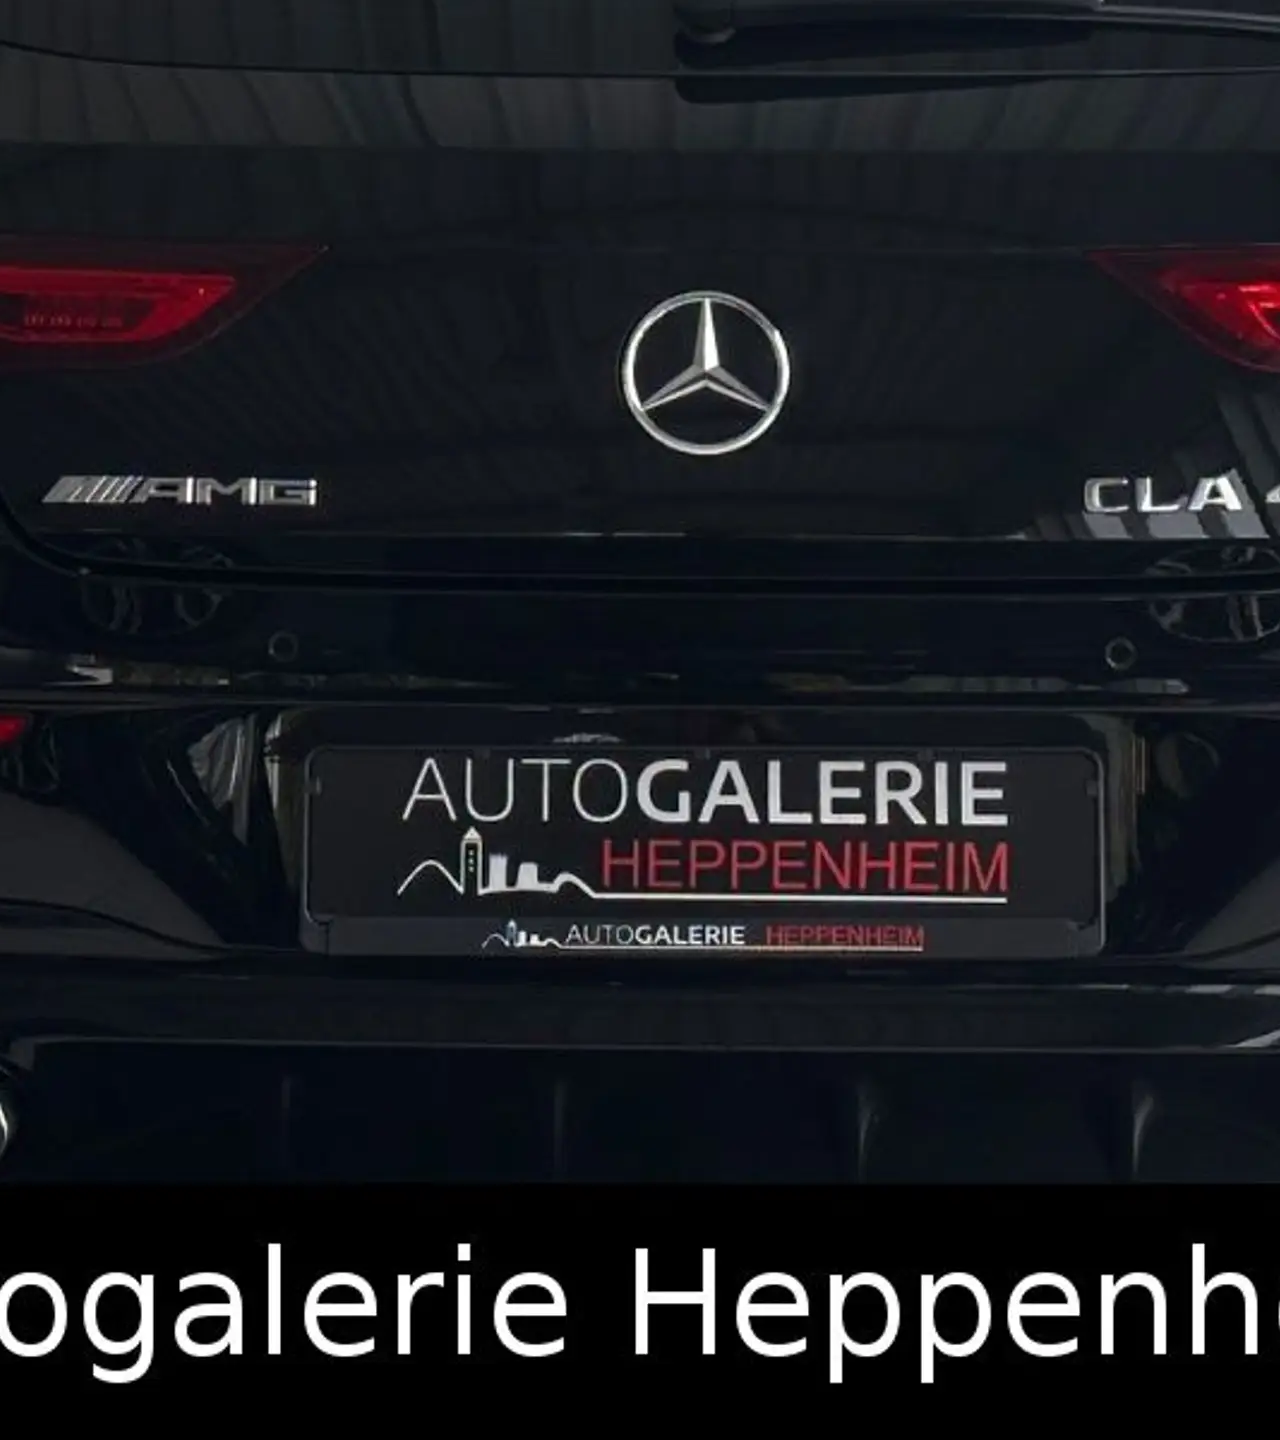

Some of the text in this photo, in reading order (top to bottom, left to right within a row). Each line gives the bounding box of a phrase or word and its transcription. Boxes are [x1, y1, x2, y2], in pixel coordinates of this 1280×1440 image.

[131, 476, 318, 507] AMG
[1083, 476, 1242, 514] CLA
[402, 758, 1008, 826] AUTOGALERIE
[601, 839, 1008, 892] HEPPENHEIM
[565, 923, 926, 947] AUTOGALERIE HEPPENHEIM
